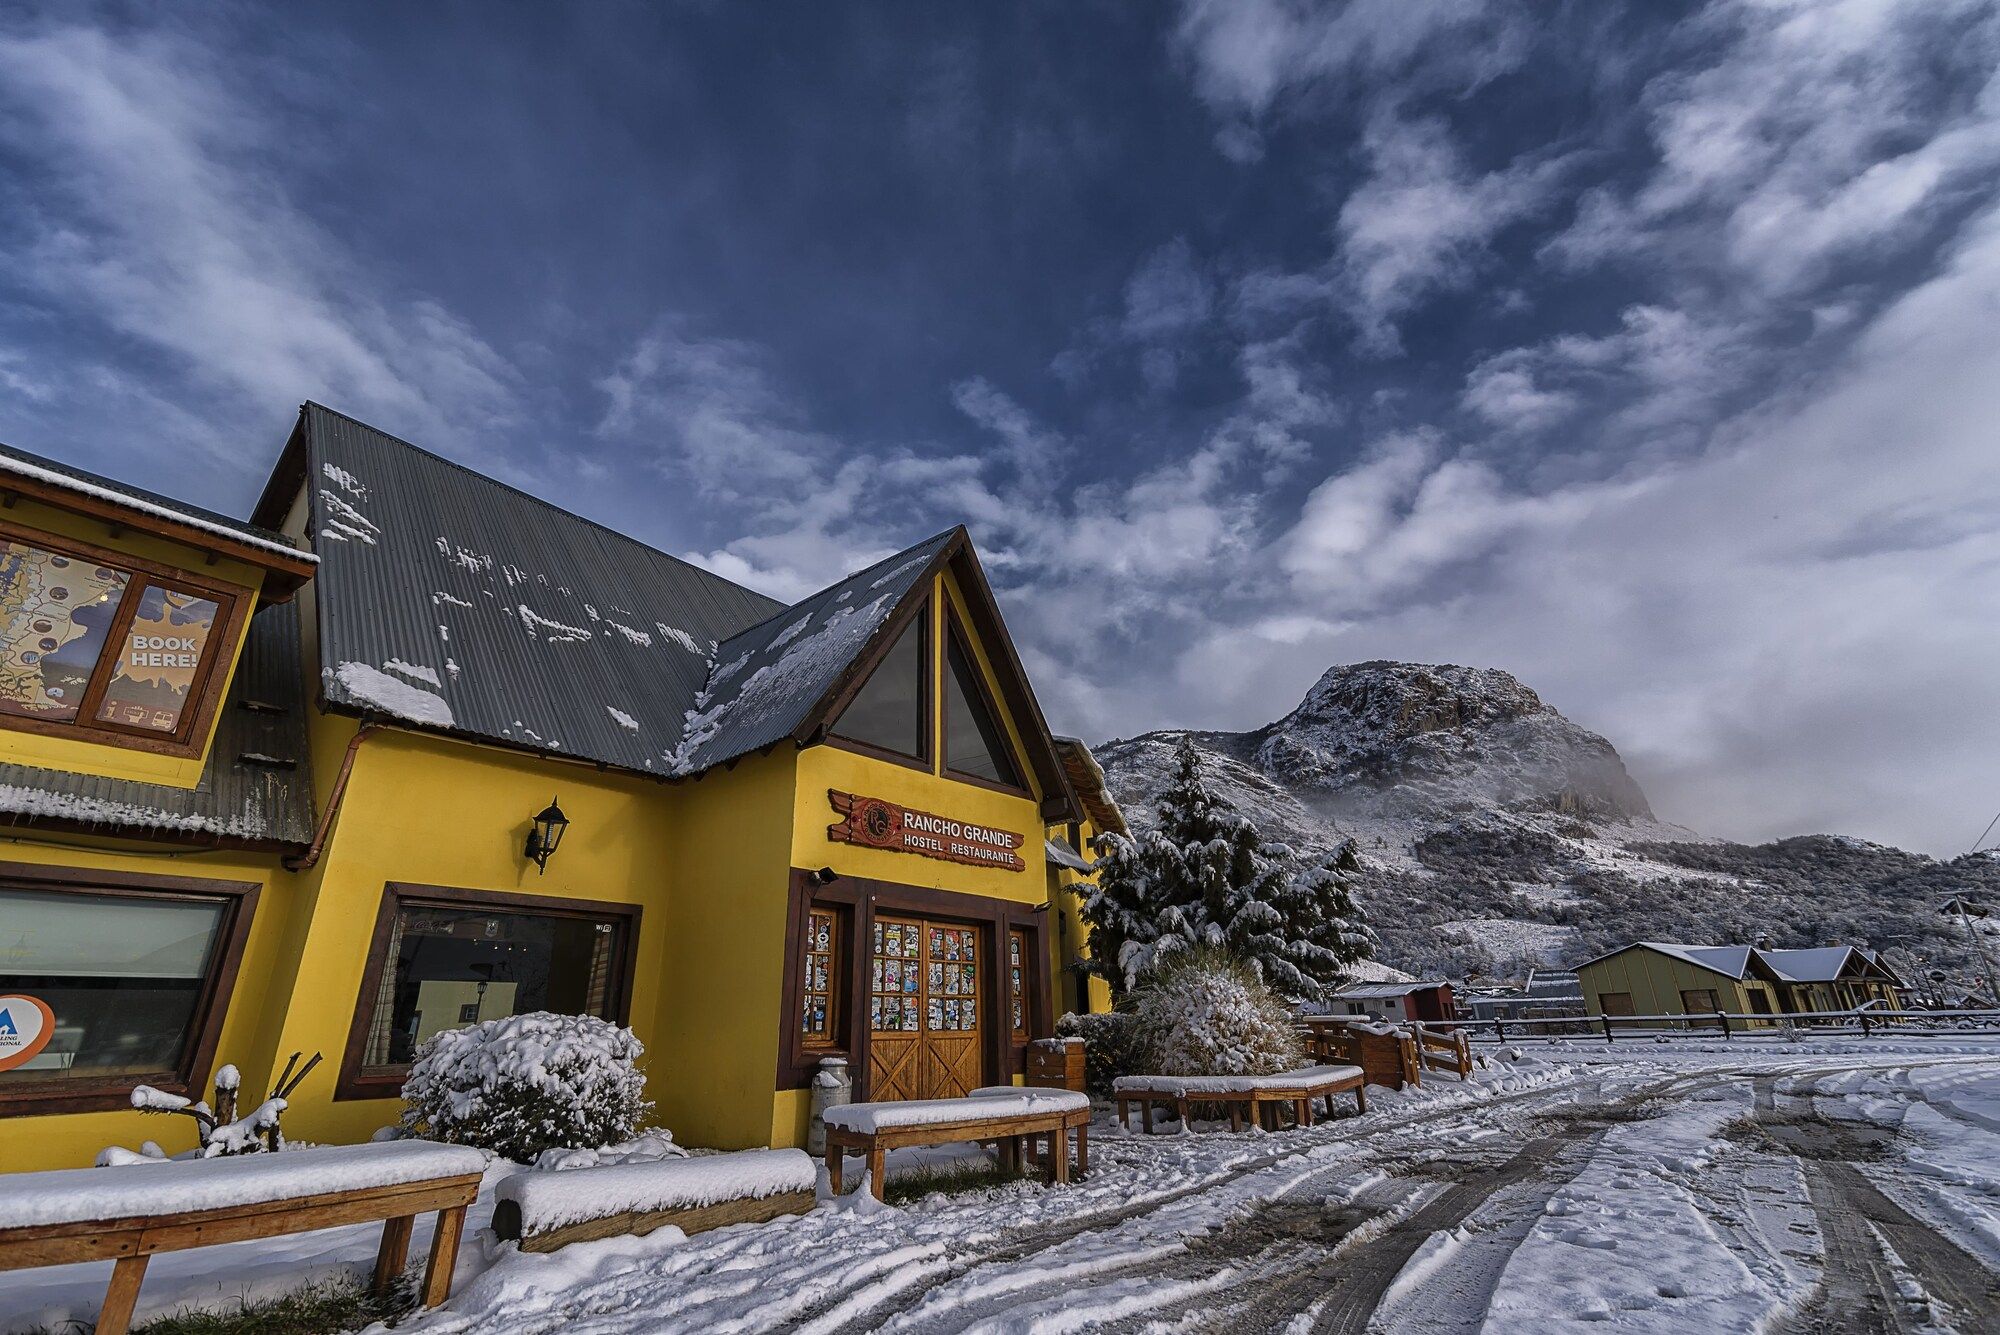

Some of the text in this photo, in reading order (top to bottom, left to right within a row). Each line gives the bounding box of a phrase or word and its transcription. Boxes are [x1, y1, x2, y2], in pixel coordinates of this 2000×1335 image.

[132, 635, 196, 651] BOOK
[131, 652, 197, 668] HERE!
[904, 812, 960, 837] RANCHO
[963, 825, 1013, 848] GRANDE
[904, 834, 1014, 864] HOSTEL RESTAURANTE
